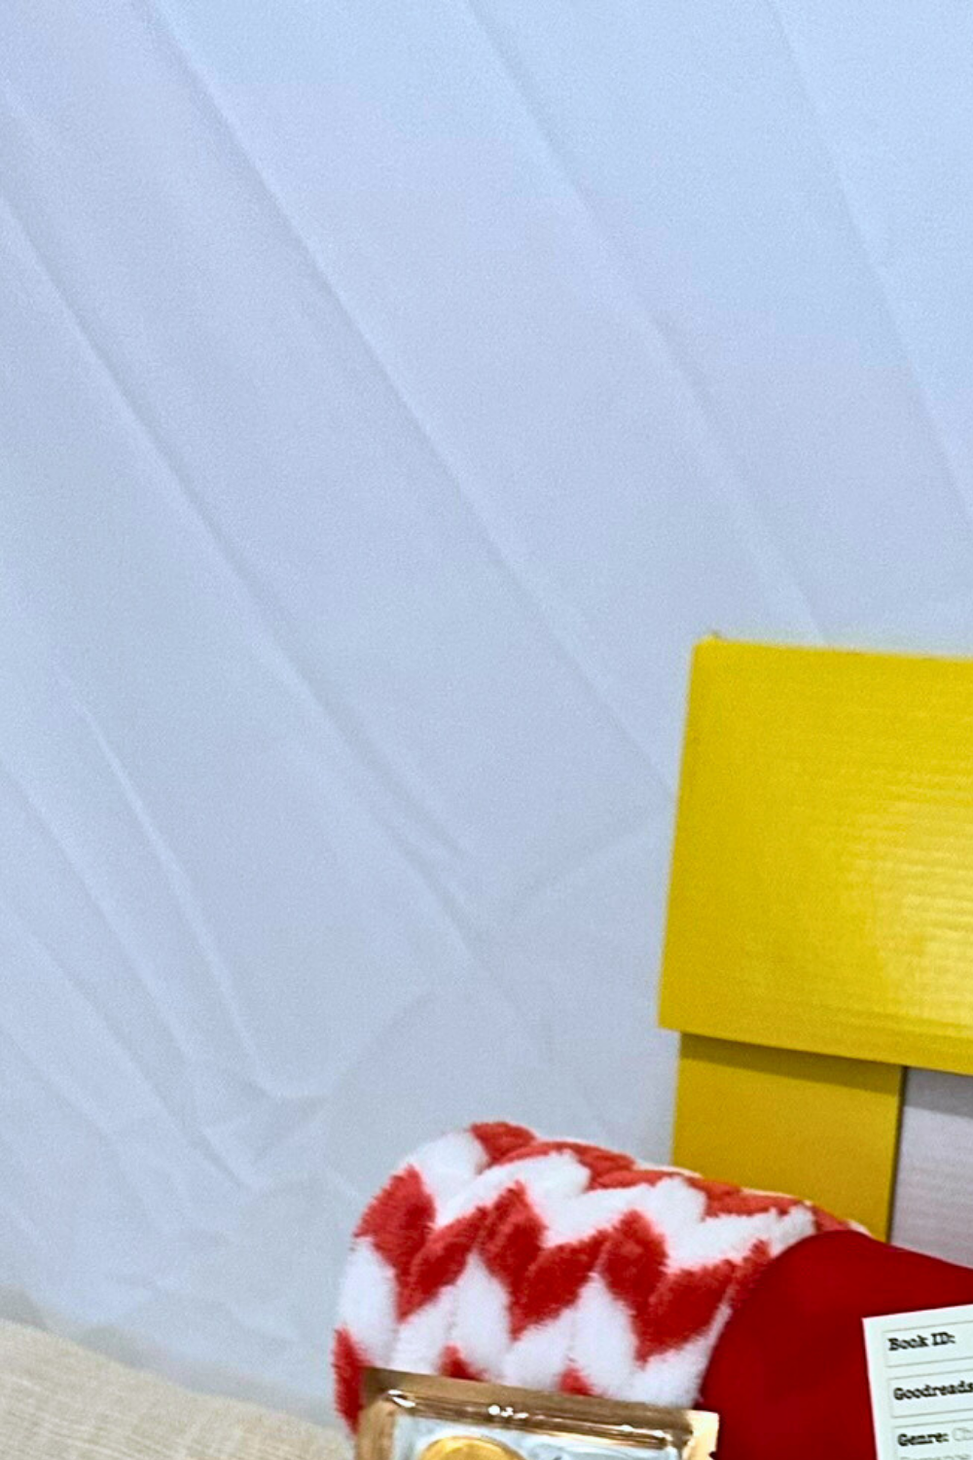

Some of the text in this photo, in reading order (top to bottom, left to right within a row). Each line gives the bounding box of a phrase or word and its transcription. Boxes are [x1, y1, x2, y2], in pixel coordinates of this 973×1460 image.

[888, 1332, 929, 1352] Book
[930, 1330, 956, 1347] ID:
[897, 1431, 949, 1447] Genre:
